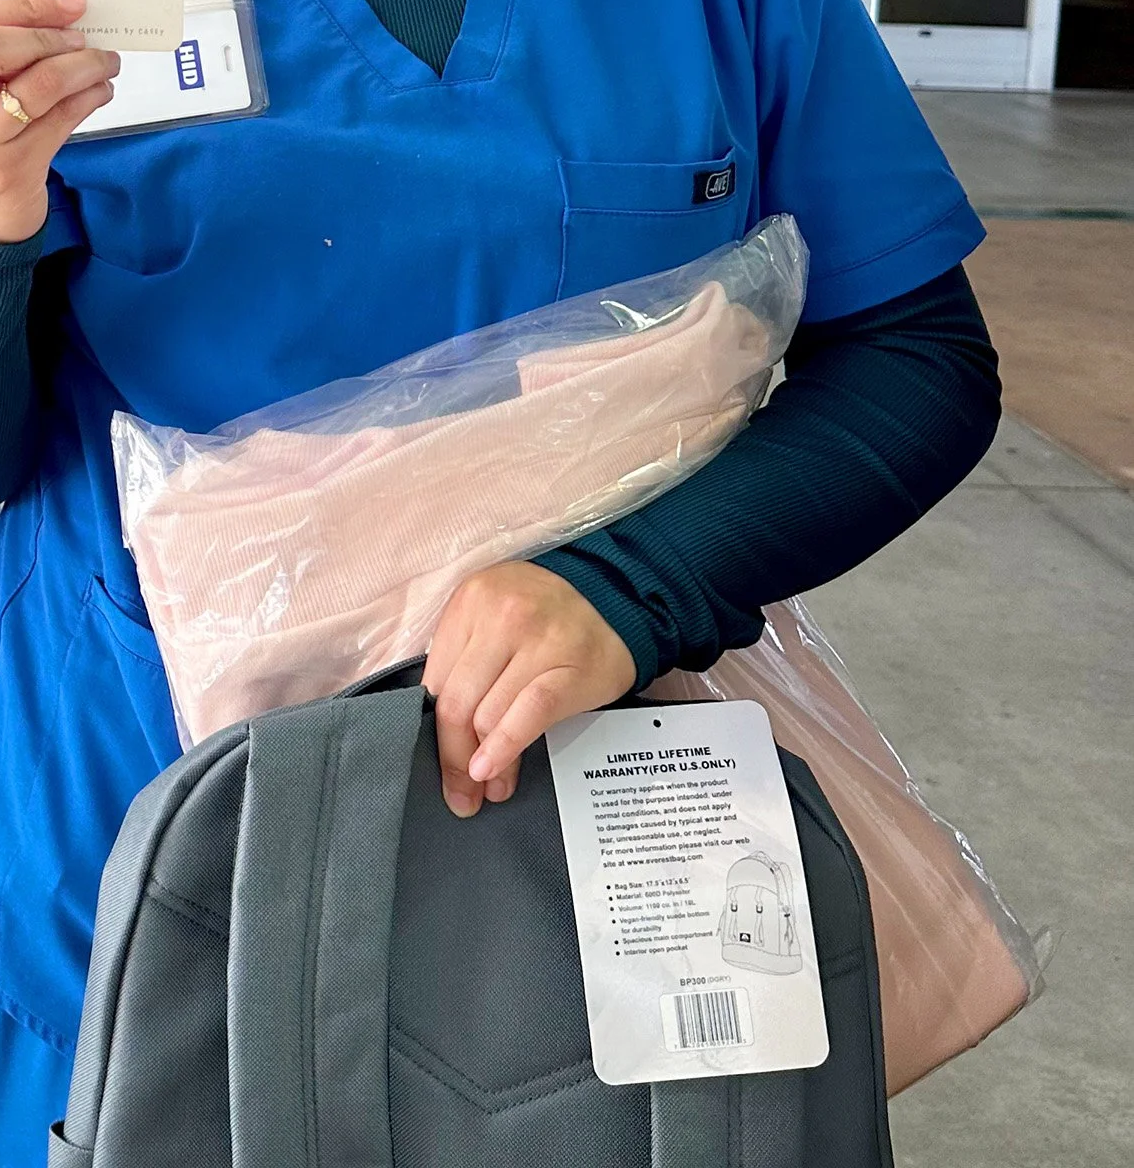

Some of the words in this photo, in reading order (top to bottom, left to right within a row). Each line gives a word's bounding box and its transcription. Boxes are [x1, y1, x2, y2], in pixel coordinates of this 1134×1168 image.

[179, 45, 199, 86] HID
[607, 751, 654, 764] LIMITED
[659, 746, 712, 759] LIFETIME
[583, 762, 677, 779] WARRANTY(FOR
[679, 758, 736, 772] U.S.ONLY)
[590, 788, 604, 797] Our
[606, 786, 637, 796] warranty
[638, 784, 664, 795] applies
[666, 781, 685, 789] when
[686, 780, 699, 789] the
[700, 778, 728, 790] product
[593, 799, 600, 808] is
[601, 798, 619, 808] used
[620, 797, 631, 806] for
[632, 796, 644, 805] the
[645, 794, 675, 806] purpose
[677, 792, 709, 801] intended,
[711, 790, 733, 799] under
[595, 812, 620, 820] normal
[621, 808, 662, 818] conditions,
[663, 806, 677, 815] and
[679, 805, 697, 813] does
[698, 804, 710, 812] not
[711, 802, 731, 812] apply
[596, 825, 604, 833] to
[606, 822, 638, 833] damages
[640, 820, 666, 829] caused
[667, 819, 677, 829] by
[678, 817, 703, 828] typical
[704, 816, 722, 824] wear
[723, 813, 737, 822] and
[598, 837, 616, 845] tear,
[616, 833, 665, 843] unreasonable
[666, 831, 683, 840] use,
[693, 827, 722, 838] neglect.
[601, 848, 614, 857] For
[615, 847, 634, 855] more
[635, 843, 677, 853] information
[678, 841, 703, 850] please
[704, 839, 719, 848] visit
[734, 836, 750, 845] web
[603, 859, 616, 868] site
[618, 858, 626, 867] at
[626, 853, 703, 866] www.everestbag.com
[614, 883, 628, 891] Bag
[629, 881, 644, 889] Size:
[616, 892, 643, 900] Material:
[662, 889, 690, 897] Polyester
[619, 914, 665, 924] Vegan-friendly
[666, 912, 686, 920] suede
[687, 910, 710, 918] bottom
[622, 936, 652, 945] Spacious
[653, 934, 669, 942] main
[671, 931, 713, 941] compartment
[632, 925, 662, 934] durability
[624, 948, 647, 956] Interior
[649, 946, 665, 955] open
[666, 944, 688, 953] pocket
[680, 977, 706, 986] BP300
